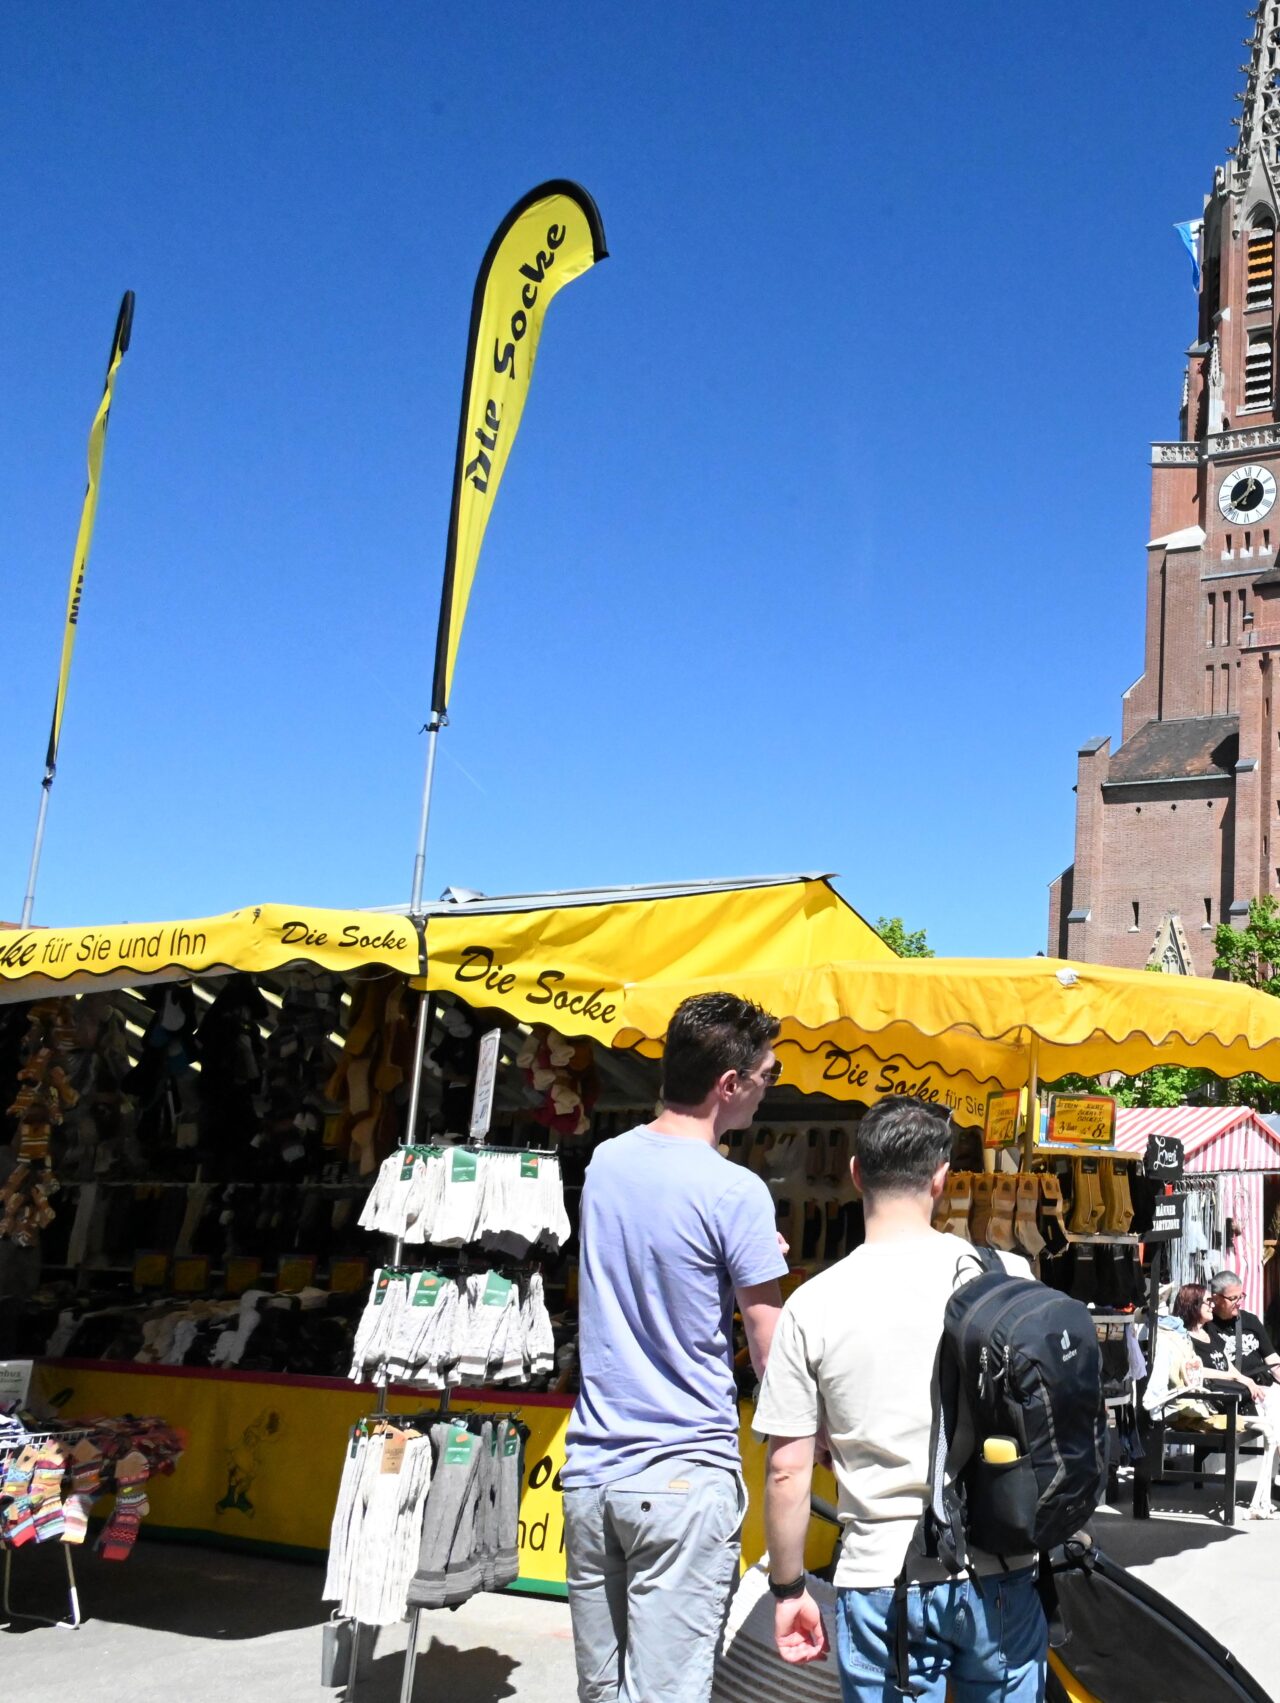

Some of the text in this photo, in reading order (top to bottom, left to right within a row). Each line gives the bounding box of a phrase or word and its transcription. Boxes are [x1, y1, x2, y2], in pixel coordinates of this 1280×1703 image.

[493, 222, 567, 380] Socke
[0, 928, 206, 968] ke für Sie und Ihn
[280, 921, 408, 950] Die Socke
[454, 945, 616, 1025] Die Socke
[822, 1050, 985, 1118] Die Socke für Sie
[517, 1512, 550, 1552] nd
